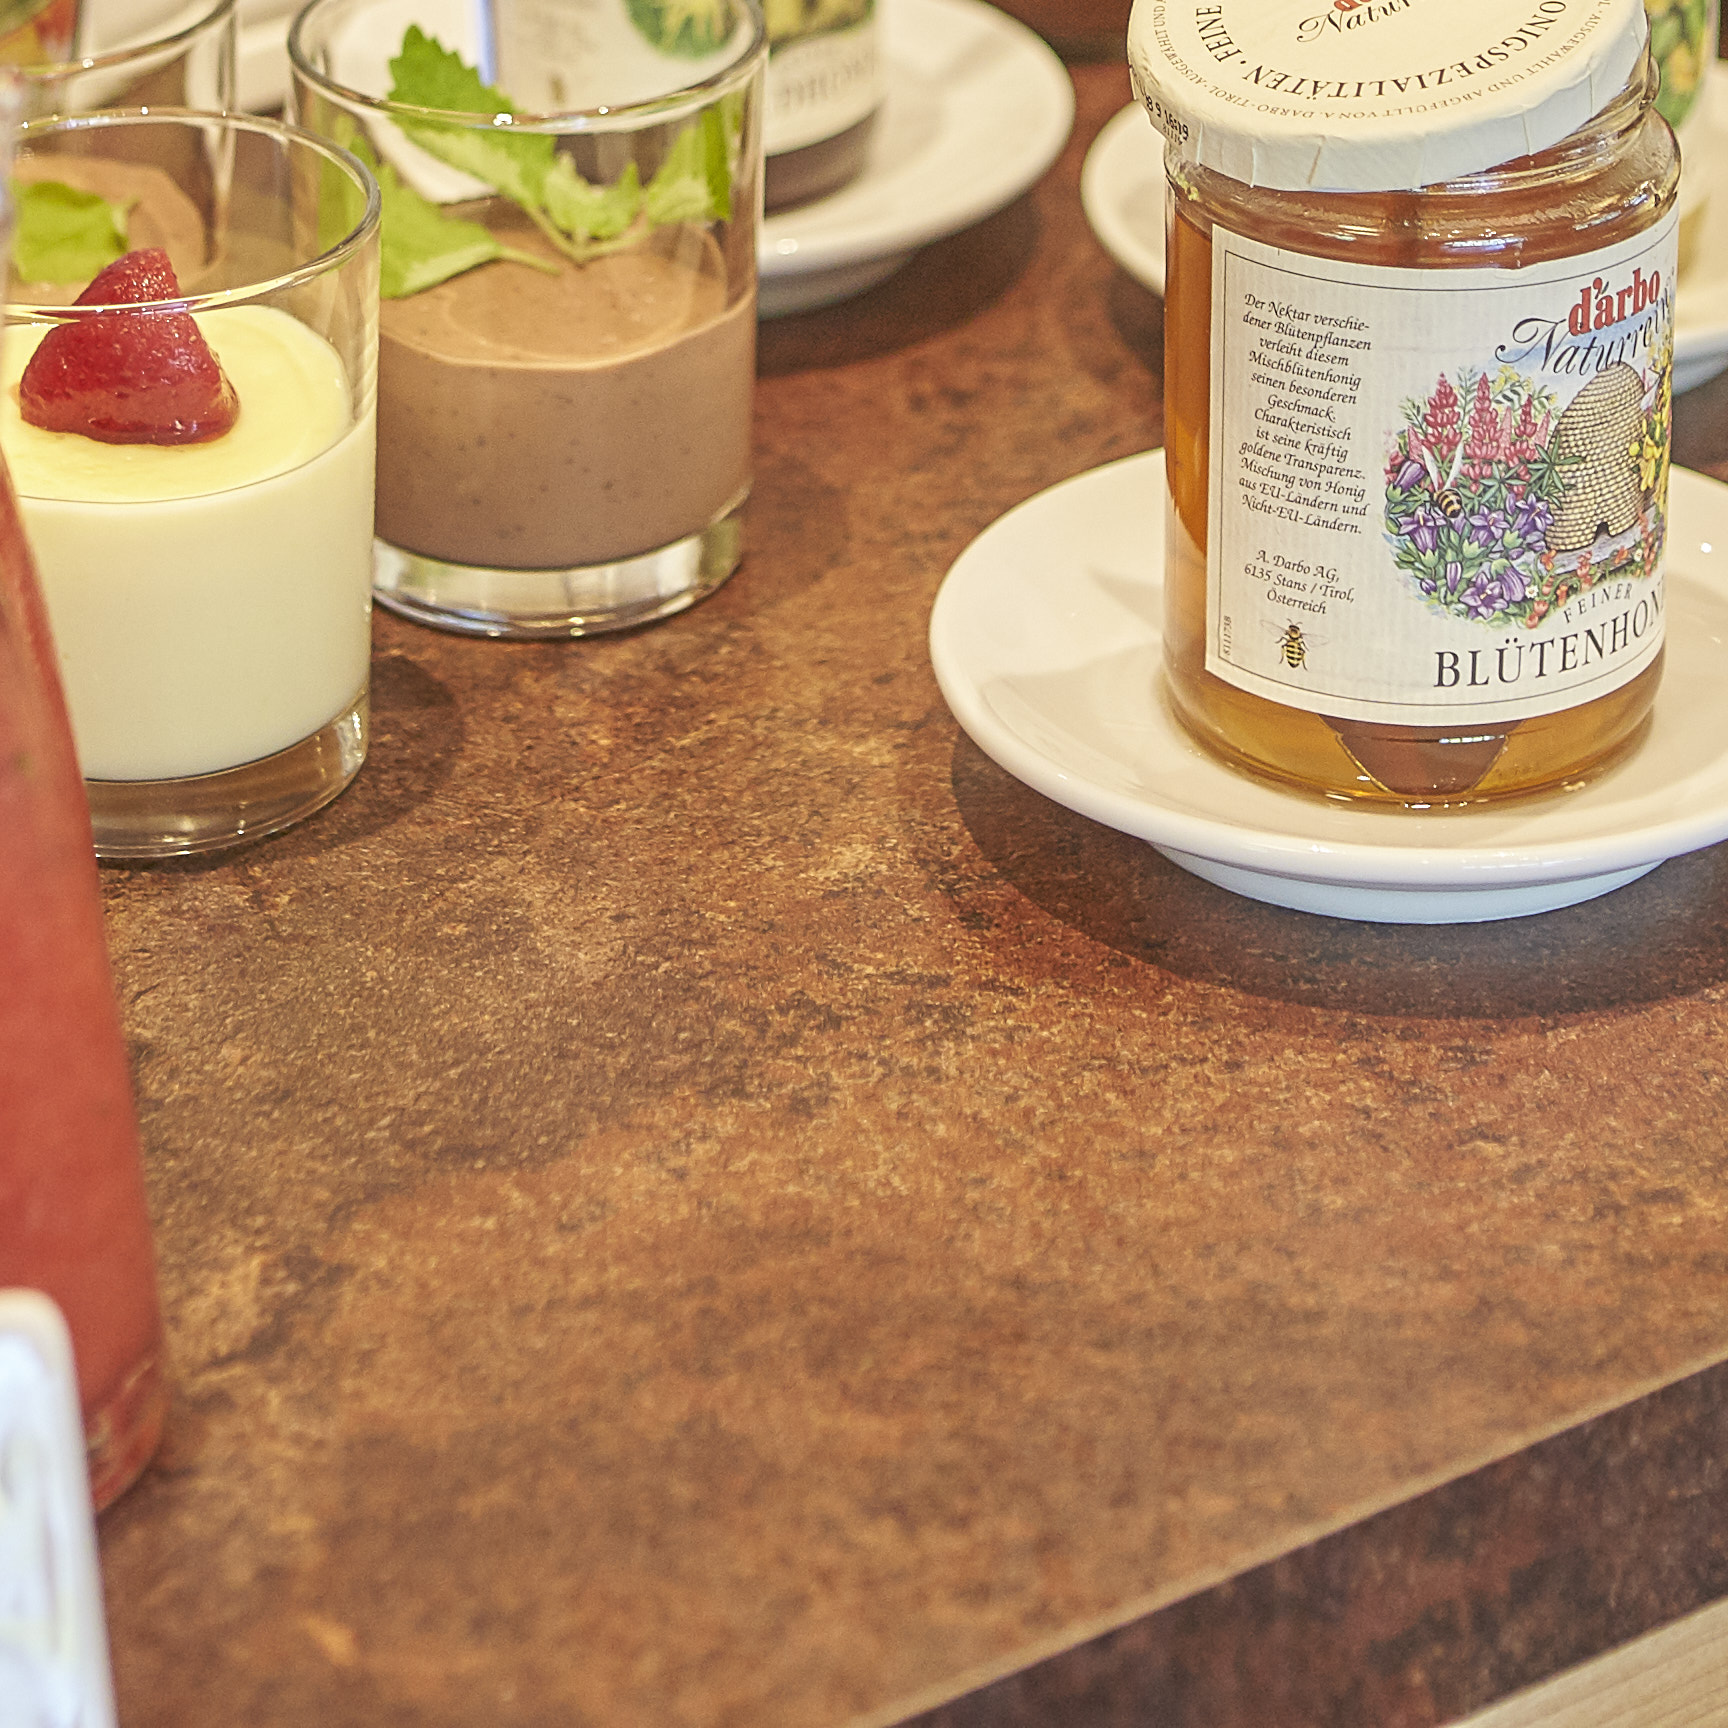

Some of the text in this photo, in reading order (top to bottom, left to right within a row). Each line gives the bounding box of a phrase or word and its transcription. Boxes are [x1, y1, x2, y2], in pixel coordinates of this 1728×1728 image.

[1153, 5, 1166, 29] UND
[1195, 4, 1242, 62] FEINE
[1208, 85, 1250, 108] TIROL
[1487, 73, 1526, 93] UND
[1256, 103, 1315, 119] DARBO
[1243, 310, 1372, 351] dener Blütenpflanzen
[1244, 293, 1370, 332] Der Nektar verschie-
[1495, 275, 1672, 376] Naturrein
[1259, 336, 1349, 366] verleiht diesem
[1248, 350, 1362, 392] Mischblütenhonig
[1251, 371, 1357, 405] seinen besonderen
[1254, 408, 1351, 441] Charakteristisch
[1267, 394, 1337, 422] Geschmack.
[1238, 441, 1366, 480] goldene Transparenz.
[1256, 426, 1349, 463] ist seine kräftig
[1238, 475, 1371, 517] aus EU-Ländern und
[1240, 457, 1367, 503] Mischung von Honig
[1241, 493, 1362, 535] Nicht-EU-Ländern.
[1244, 563, 1271, 582] 6135
[1273, 573, 1308, 592] Stans
[1319, 584, 1355, 603] Tirol,
[1256, 549, 1340, 583] A. Darbo AG,
[1267, 587, 1327, 615] Österreich
[1563, 582, 1633, 624] FEINER
